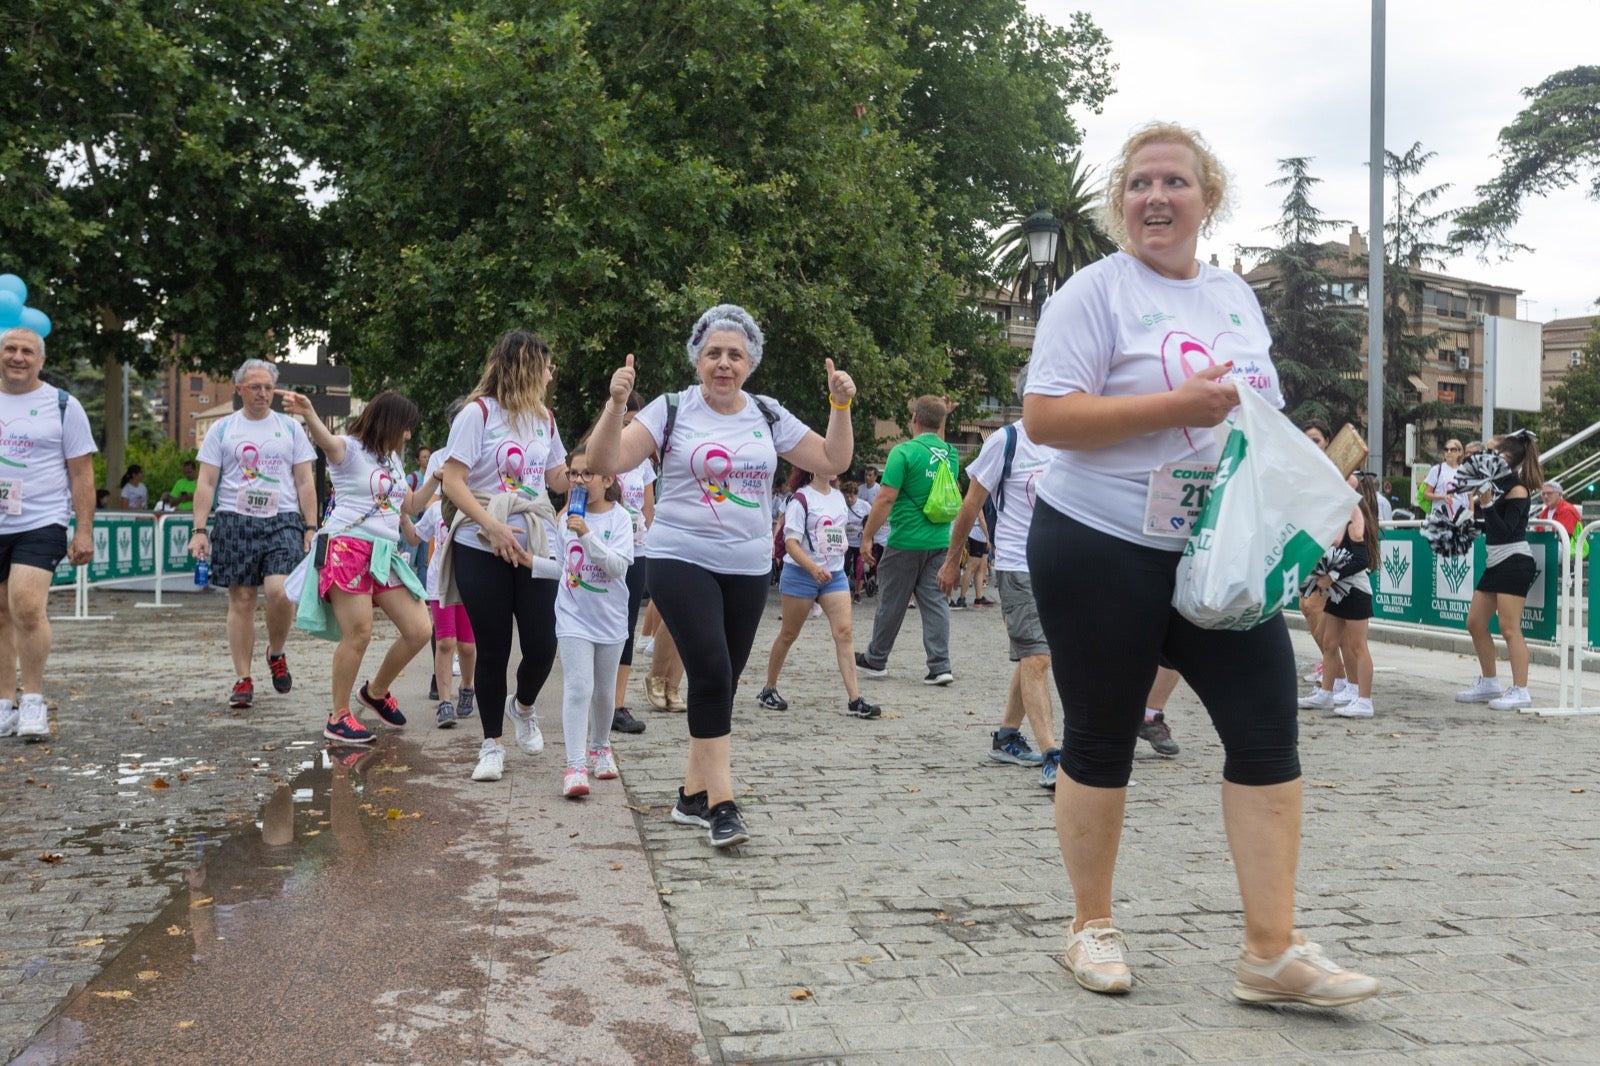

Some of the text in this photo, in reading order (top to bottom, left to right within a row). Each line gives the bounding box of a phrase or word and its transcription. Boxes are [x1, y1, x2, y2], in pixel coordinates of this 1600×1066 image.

[1171, 469, 1214, 480] COVIR
[1180, 483, 1210, 508] 21
[1375, 594, 1412, 607] CAJA RURAL
[1431, 600, 1471, 613] CAJA RURA
[1382, 605, 1404, 614] GRANADA
[1521, 608, 1545, 622] URAL
[1439, 612, 1464, 621] GRANADA
